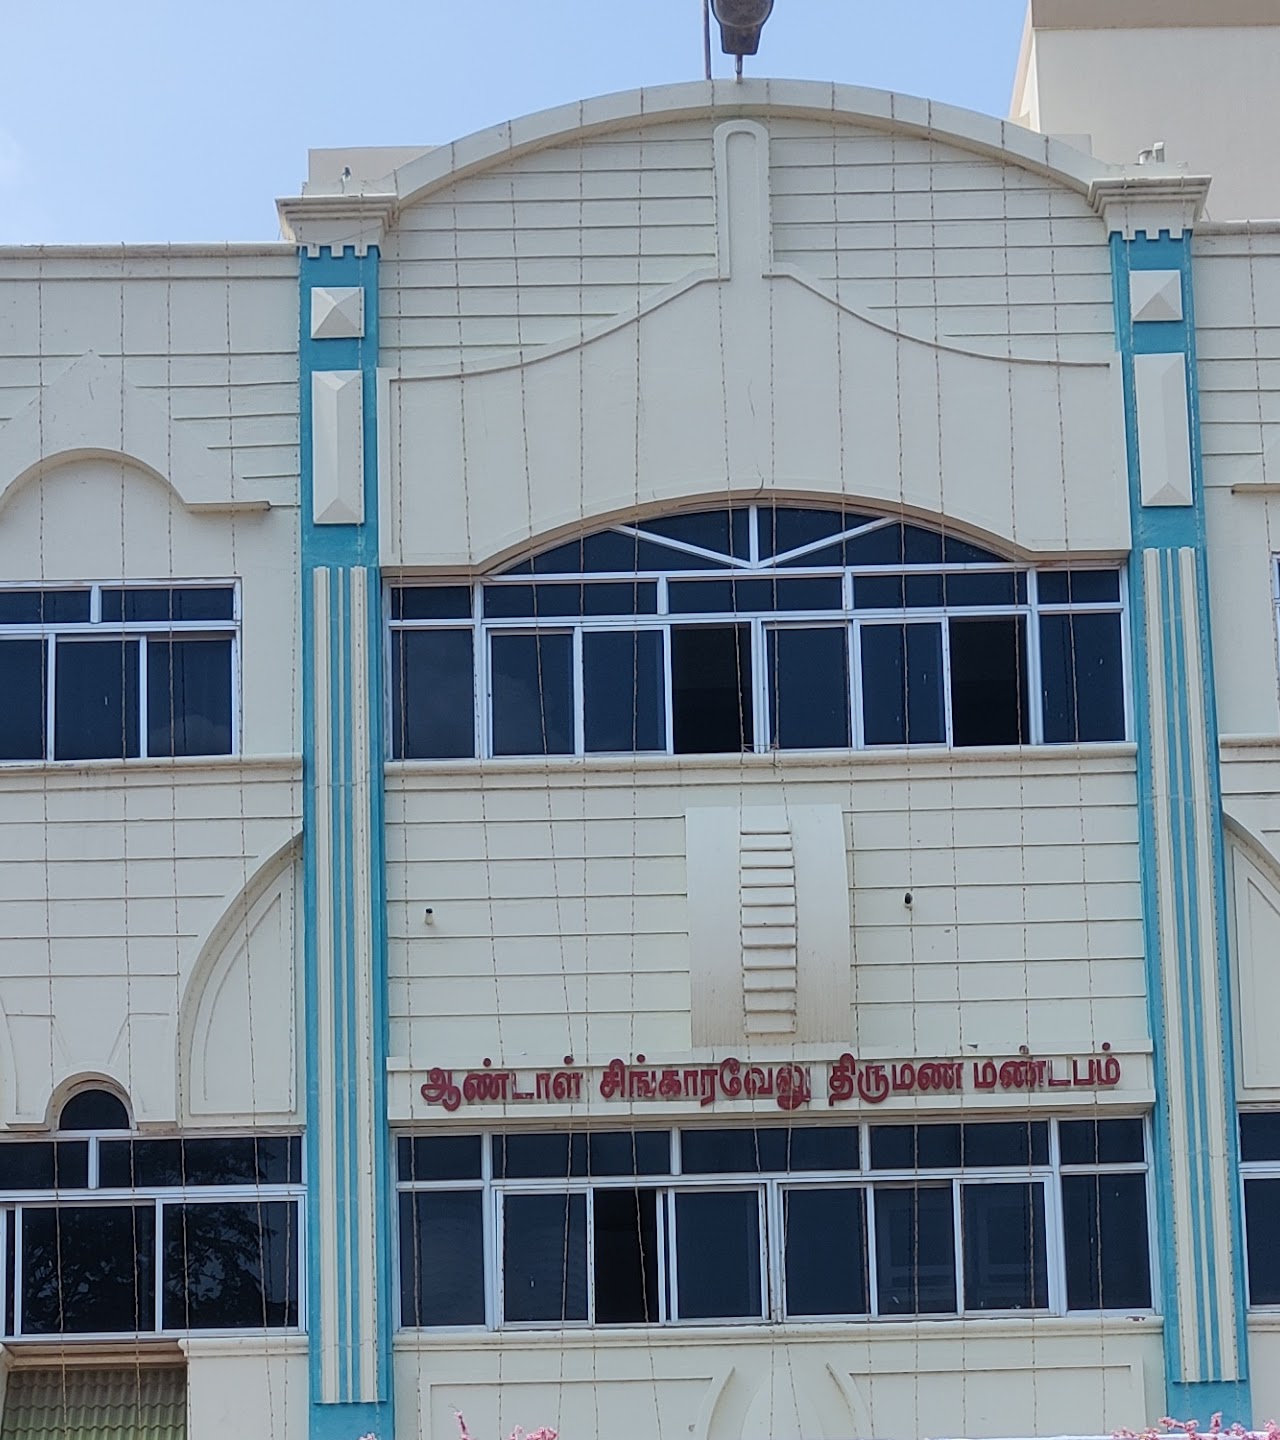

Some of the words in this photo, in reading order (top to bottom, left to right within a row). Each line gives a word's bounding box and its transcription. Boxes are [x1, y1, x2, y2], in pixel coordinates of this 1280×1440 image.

[420, 1054, 584, 1112] ஆண்டாள்
[599, 1053, 812, 1111] சிங்காரவேலு
[828, 1052, 964, 1107] திருமண
[973, 1041, 1122, 1089] மண்டபம்
